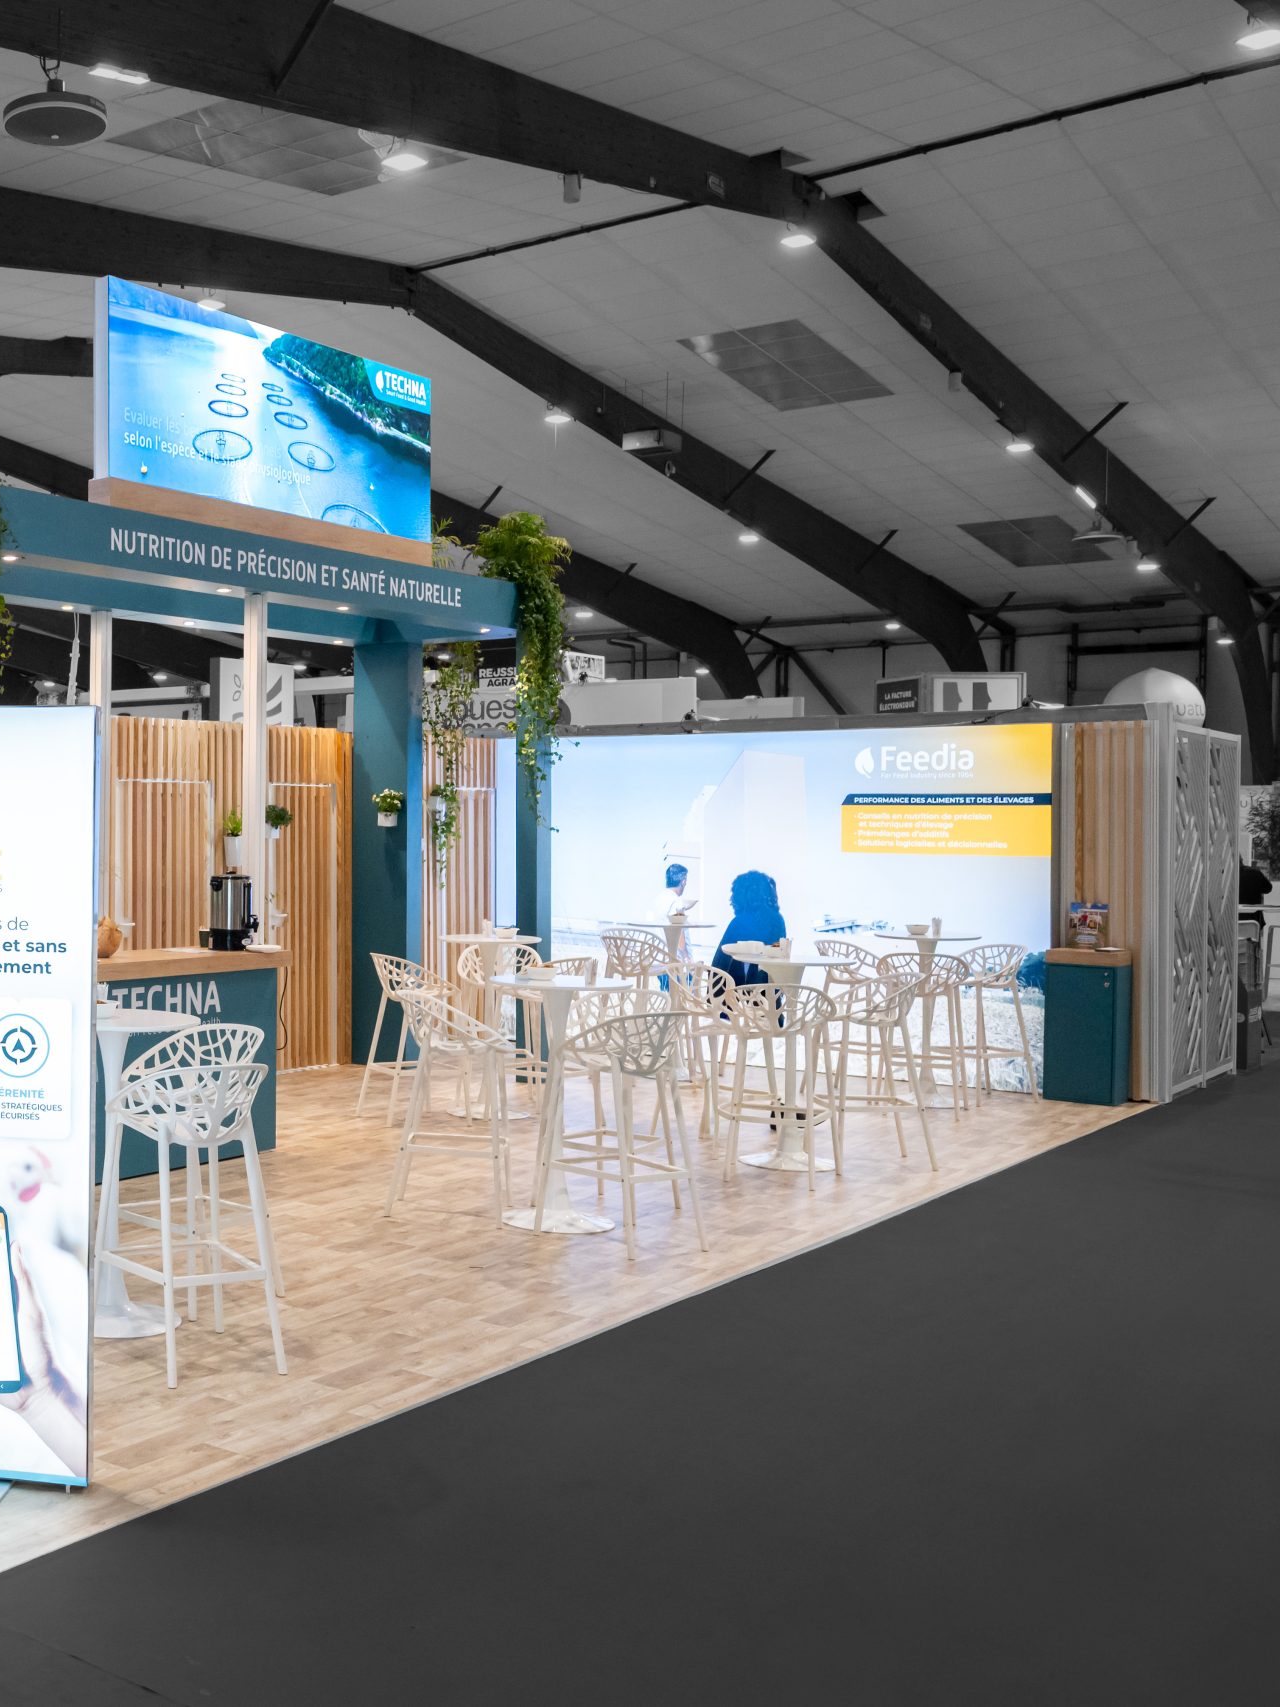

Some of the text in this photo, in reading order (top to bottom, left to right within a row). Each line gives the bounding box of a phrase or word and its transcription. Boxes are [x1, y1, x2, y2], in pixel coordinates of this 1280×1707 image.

[384, 370, 427, 400] TECHNA
[124, 431, 152, 449] selon
[110, 527, 462, 608] NUTRITION DE PRÉCISION ET SANTÉ NATURELLE
[487, 678, 516, 687] AGRA
[881, 743, 974, 771] Feedia
[994, 795, 1035, 804] ÉLEVAGES
[8, 916, 30, 931] de
[2, 939, 21, 952] et
[26, 941, 67, 953] sans
[112, 981, 221, 1015] TECHNA
[201, 1017, 221, 1026] ealth
[1, 1101, 62, 1113] STRATÉGIQUES
